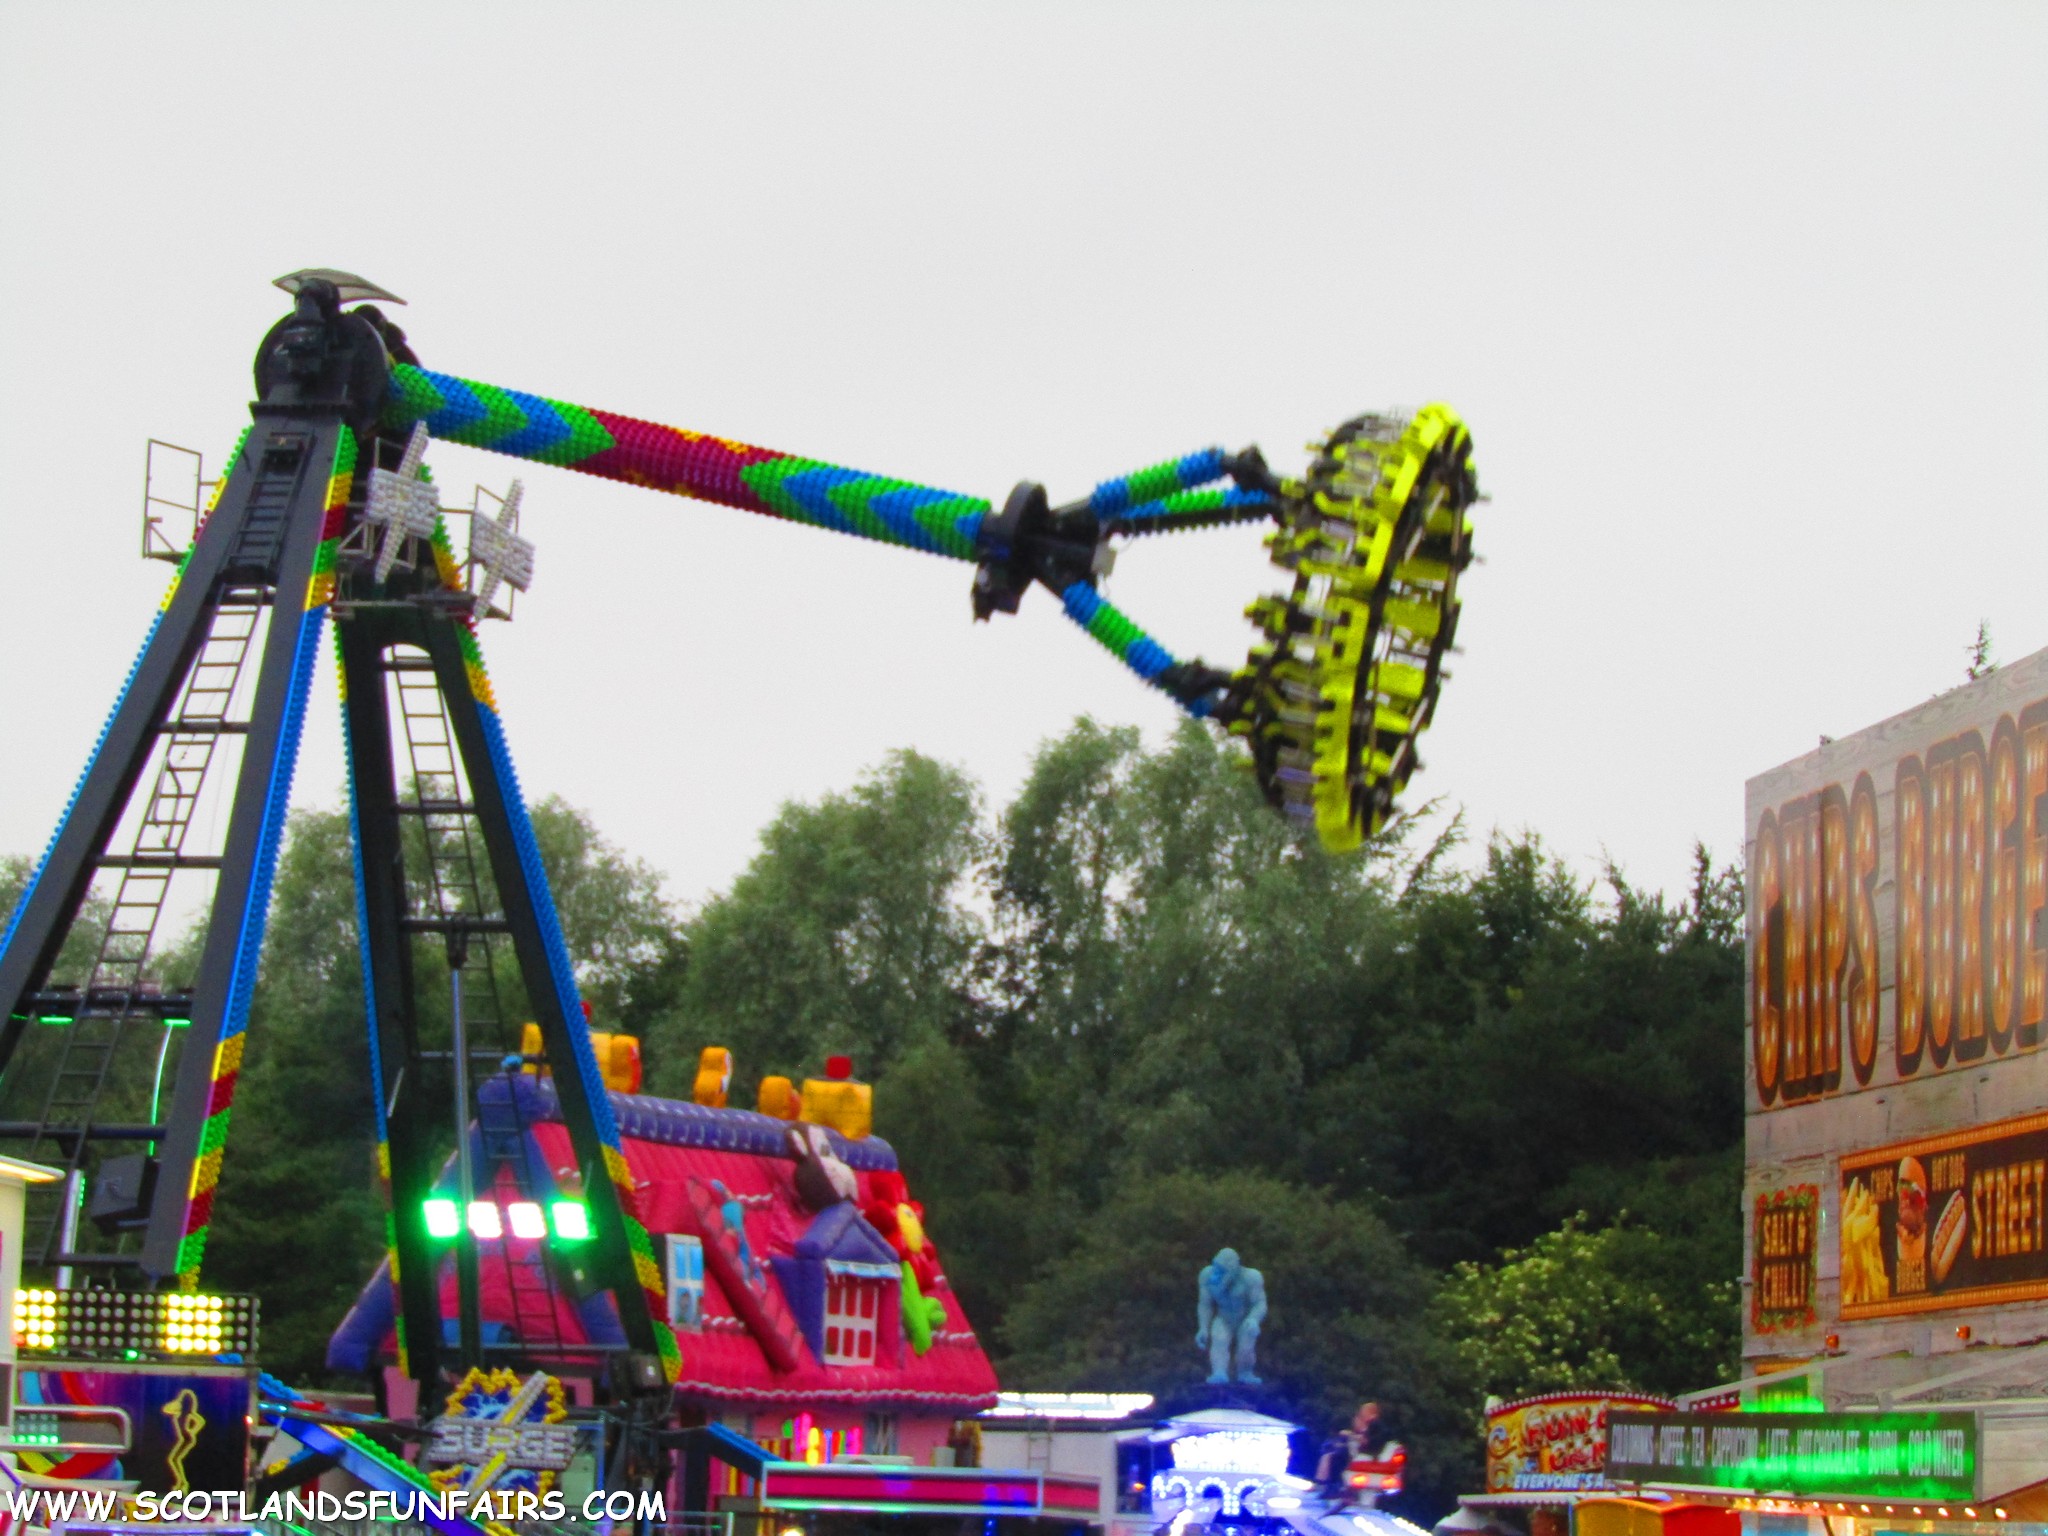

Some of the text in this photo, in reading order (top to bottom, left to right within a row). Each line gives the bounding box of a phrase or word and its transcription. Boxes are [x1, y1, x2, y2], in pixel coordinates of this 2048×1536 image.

[1753, 770, 1880, 1106] CHIPS
[1972, 1160, 2045, 1259] STREET
[1763, 1213, 1794, 1256] SALT
[437, 1424, 575, 1464] SURGE
[1660, 1425, 1685, 1465] COFFEE
[1692, 1426, 1704, 1466] TEA
[1766, 1428, 1788, 1472] LATTE
[1797, 1429, 1813, 1473] HOT
[1814, 1429, 1860, 1474] CHOCOLATE
[1868, 1430, 1898, 1475] BOVRIL
[1909, 1429, 1931, 1476] COLD
[1933, 1430, 1963, 1476] WATER
[1514, 1473, 1594, 1489] EVERYONE'S
